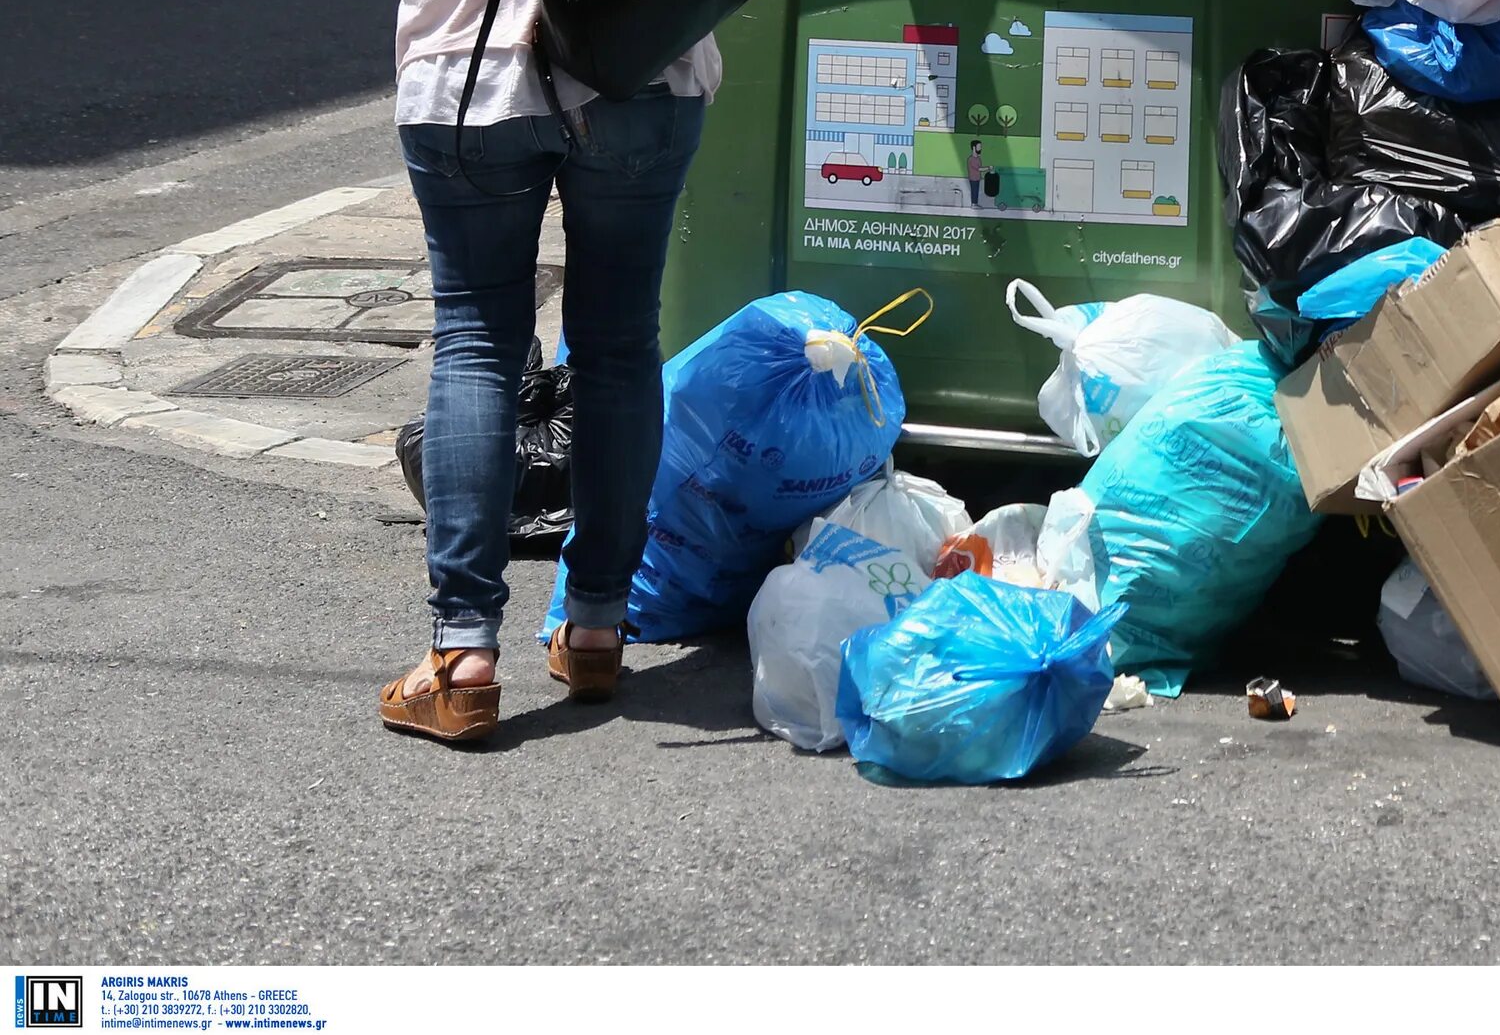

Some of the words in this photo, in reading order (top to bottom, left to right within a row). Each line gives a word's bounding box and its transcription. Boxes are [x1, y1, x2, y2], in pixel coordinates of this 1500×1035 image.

[804, 217, 858, 234] ΔΗΜΟΣ
[861, 221, 939, 239] ΑΘΗΝΑΙΩΝ
[942, 226, 976, 241] 2017
[803, 235, 824, 248] ΓΙΑ
[827, 237, 851, 250] ΜΙΑ
[854, 238, 901, 253] ΑΘΗΝΑ
[904, 240, 961, 257] ΚΑΘΑΡΗ
[1092, 250, 1183, 267] cityofathens.gr
